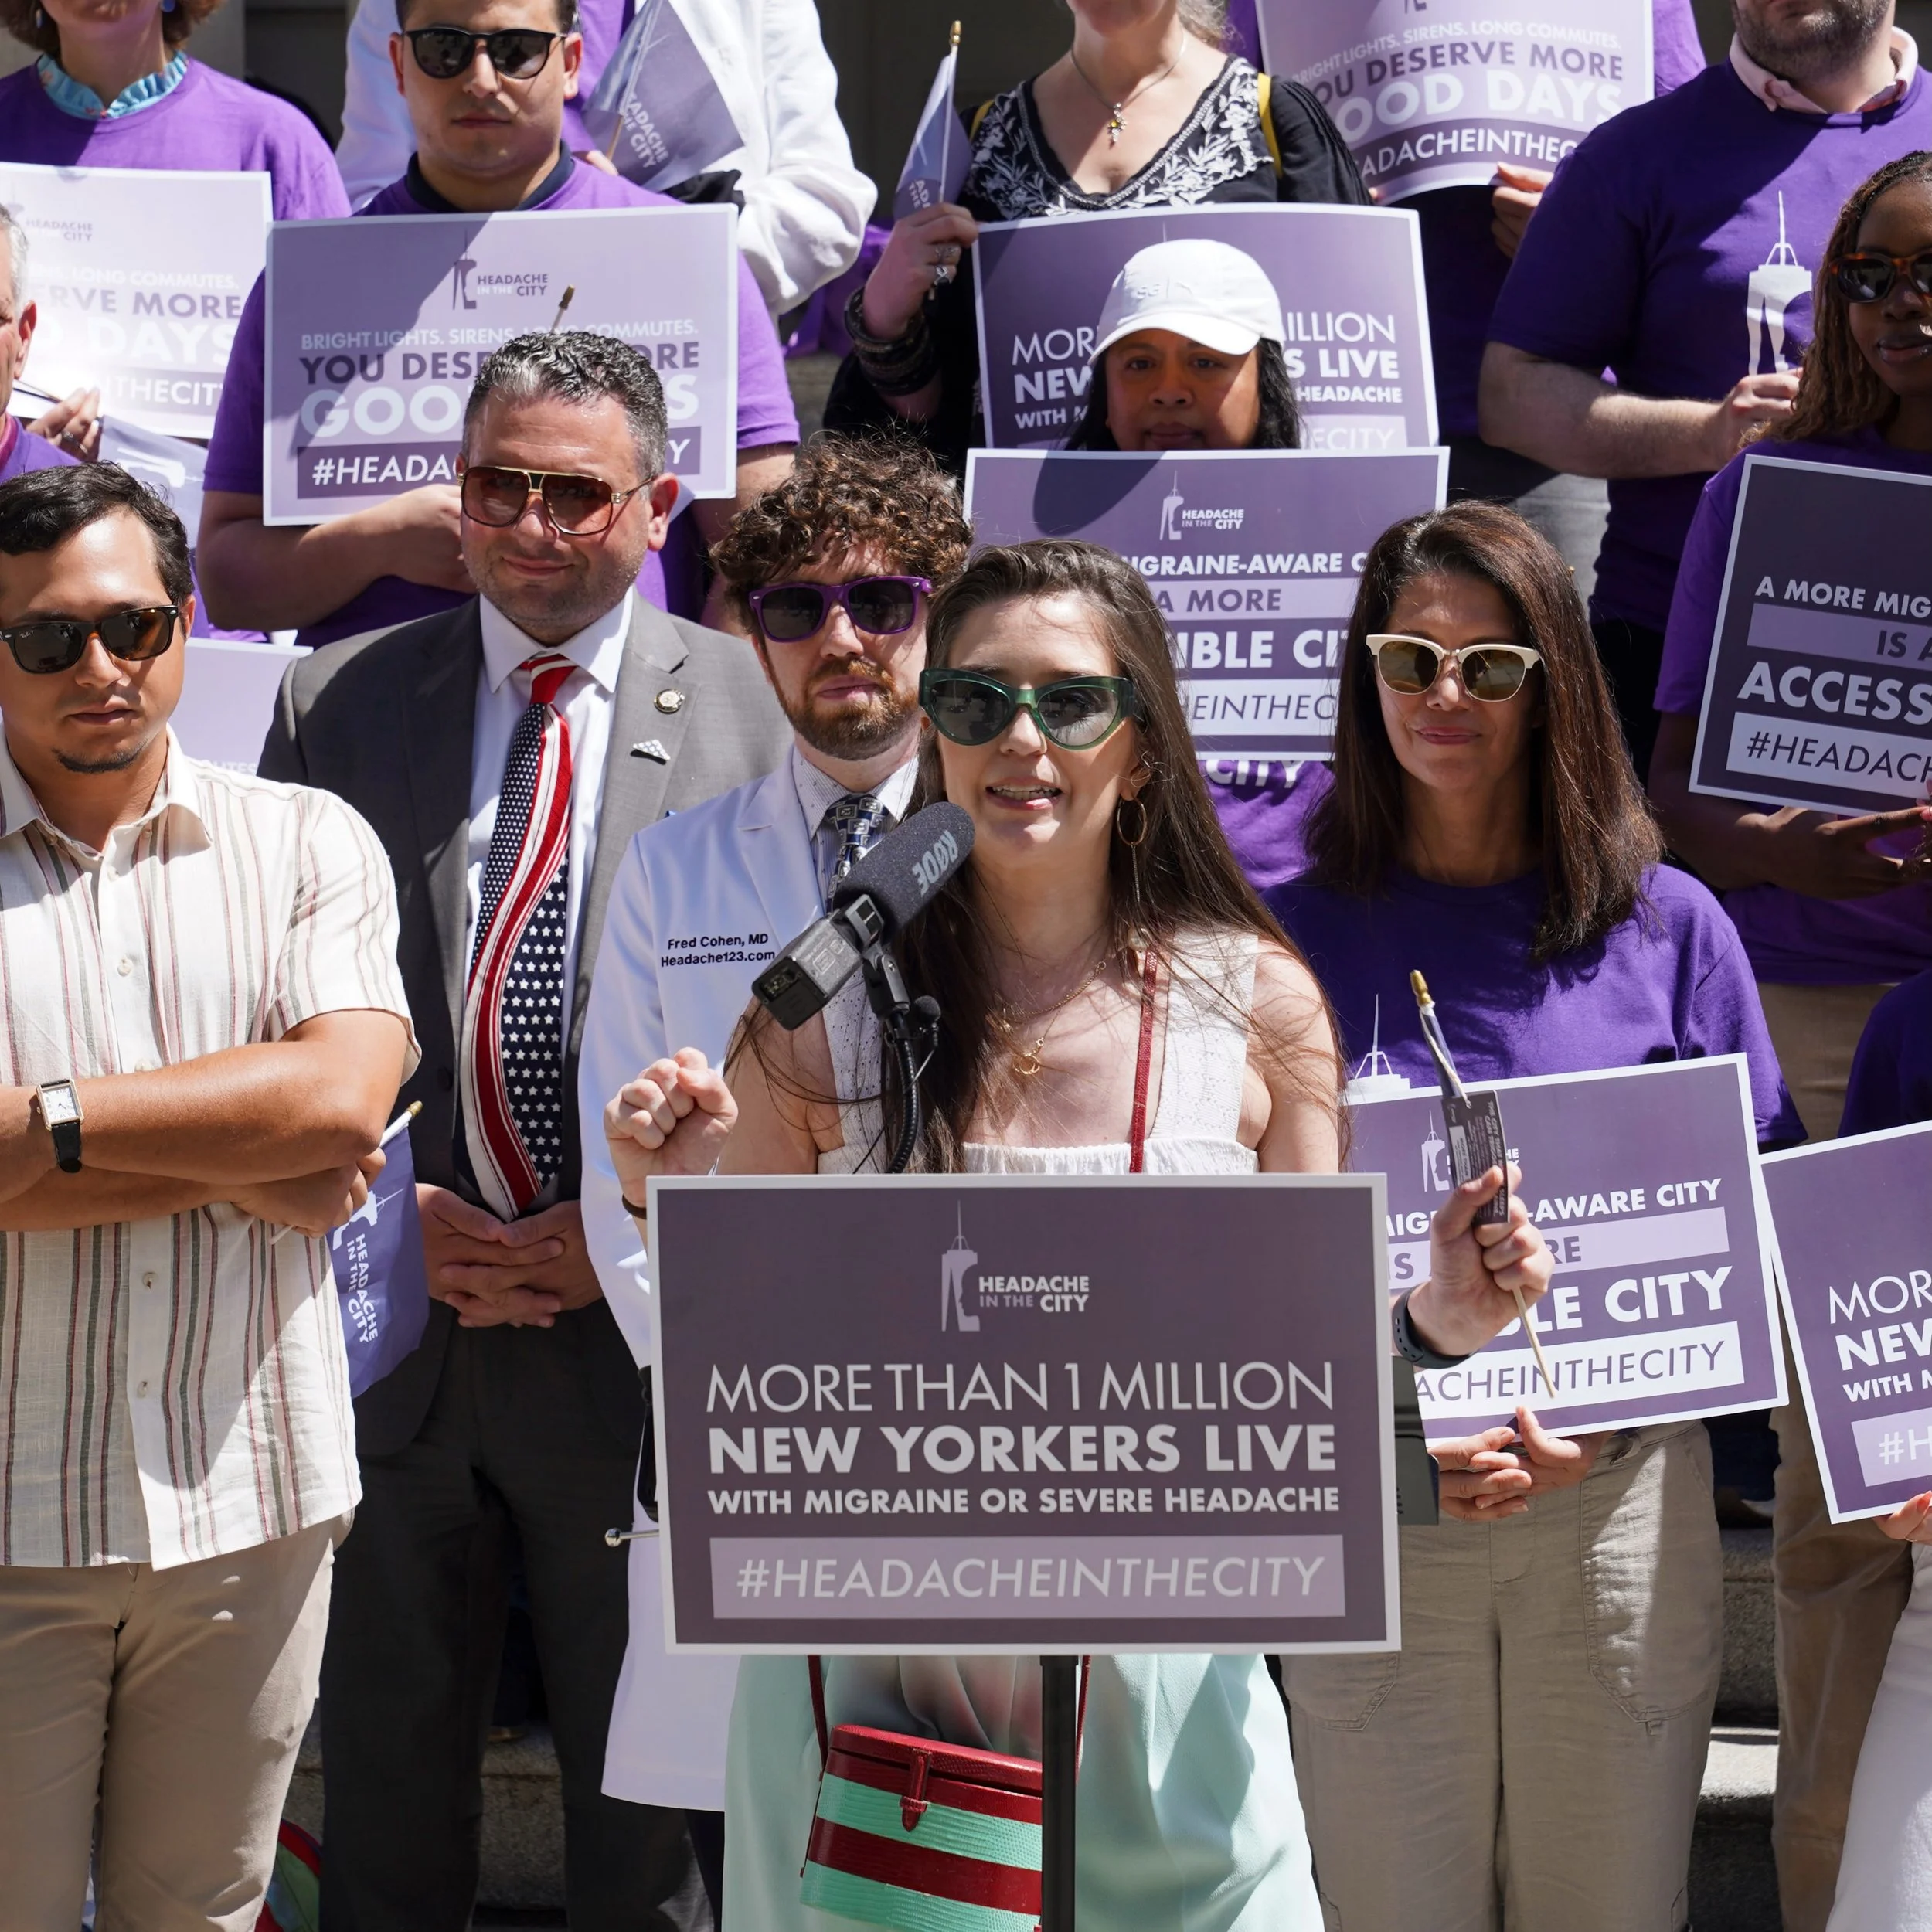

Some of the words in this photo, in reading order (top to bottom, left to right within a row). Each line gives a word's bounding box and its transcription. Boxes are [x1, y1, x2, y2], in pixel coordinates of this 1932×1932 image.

[1342, 33, 1400, 65] LIGHTS.
[1403, 21, 1468, 45] SIRENS.
[1471, 19, 1524, 36] LONG
[1526, 22, 1621, 50] COMMUTES.
[1314, 70, 1354, 106] OU
[1366, 41, 1515, 86] DESERVE
[1529, 43, 1623, 81] MORE
[1335, 73, 1464, 144] OOD
[1486, 69, 1622, 124] DAYS
[630, 133, 657, 168] CITY
[63, 231, 92, 243] CITY
[130, 270, 240, 290] COMMUTES.
[477, 274, 549, 286] HEADACHE
[477, 287, 489, 295] IN
[492, 286, 512, 294] THE
[516, 285, 548, 297] CITY
[131, 291, 241, 320] MORE
[301, 332, 371, 350] BRIGHT
[374, 328, 444, 347] LIGHTS.
[448, 328, 514, 345] SIRENS
[1012, 325, 1095, 366] MOR
[1283, 311, 1396, 344] ILLION
[299, 353, 385, 385] YOU
[1318, 348, 1400, 379] LIVE
[301, 384, 470, 438] GOO
[1014, 407, 1067, 430] WITH
[1295, 385, 1403, 403] HEADACHE
[1182, 509, 1244, 519] HEADACHE
[1182, 519, 1193, 528] IN
[1195, 519, 1213, 528] THE
[1214, 519, 1243, 530] CITY
[1121, 552, 1343, 577] IGRAINE-AWARE
[1186, 588, 1282, 614] MORE
[1754, 575, 1775, 598] A
[1783, 579, 1866, 610] MORE
[1876, 630, 1908, 658] IS
[1736, 661, 1932, 726] ACCESS
[667, 937, 697, 951] Fred
[699, 935, 745, 947] Cohen,
[748, 933, 769, 945] MD
[661, 951, 776, 968] Headache123.com
[1656, 1178, 1723, 1208] CITY
[347, 1240, 357, 1261] IN
[349, 1263, 358, 1293] THE
[355, 1233, 379, 1342] HEADACHE
[978, 1275, 1090, 1293] HEADACHE
[979, 1294, 999, 1308] IN
[1003, 1294, 1035, 1308] THE
[1039, 1294, 1090, 1312] CITY
[1604, 1265, 1733, 1323] CITY
[348, 1298, 369, 1343] CITY
[1417, 1339, 1725, 1403] ACHEINTHECITY
[706, 1363, 873, 1413] MORE
[883, 1362, 1048, 1412] THAN
[1064, 1362, 1080, 1410] 1
[1099, 1360, 1333, 1411] MILLION
[1842, 1372, 1913, 1403] WITH
[709, 1427, 862, 1475] NEW
[879, 1424, 1181, 1474] YORKERS
[1205, 1423, 1336, 1471] LIVE
[707, 1489, 792, 1515] WITH
[804, 1488, 969, 1515] MIGRAINE
[979, 1488, 1029, 1514] OR
[1039, 1488, 1154, 1514] SEVERE
[1164, 1487, 1340, 1512] HEADACHE
[736, 1556, 1325, 1598] #HEADACHEINTHECITY
